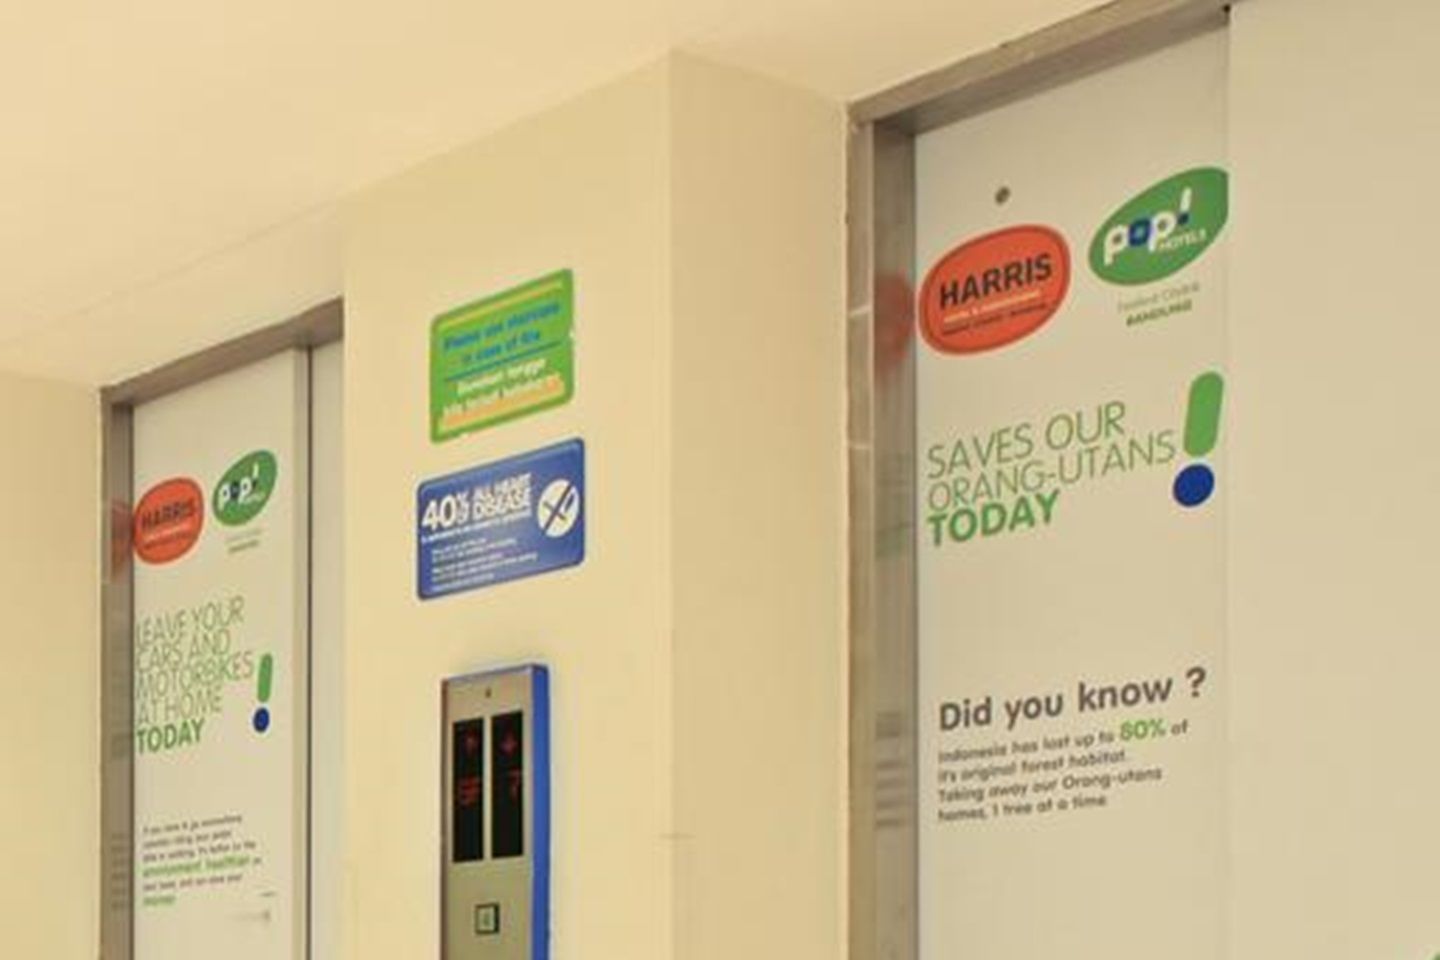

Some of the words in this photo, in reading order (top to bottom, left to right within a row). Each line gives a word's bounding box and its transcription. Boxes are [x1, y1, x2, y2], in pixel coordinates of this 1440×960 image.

[939, 252, 1053, 311] HARRIS
[927, 422, 1034, 479] SAVES
[1044, 400, 1126, 452] OUR
[928, 430, 1177, 513] ORANG-UTANS
[927, 488, 1060, 547] TODAY
[136, 609, 188, 649] LEAVE
[190, 594, 246, 631] YOUR
[137, 642, 183, 673] CARS
[188, 628, 231, 660] AND
[164, 683, 222, 721] HOME
[939, 696, 993, 732] Did
[1004, 693, 1064, 731] you
[1077, 677, 1174, 713] know
[1185, 666, 1207, 699] ?
[136, 717, 205, 755] TODAY
[1012, 740, 1038, 755] has
[1042, 734, 1071, 750] lost
[1074, 732, 1095, 749] up
[1119, 717, 1166, 742] 80%
[1170, 719, 1189, 736] of
[1021, 758, 1064, 774] forest
